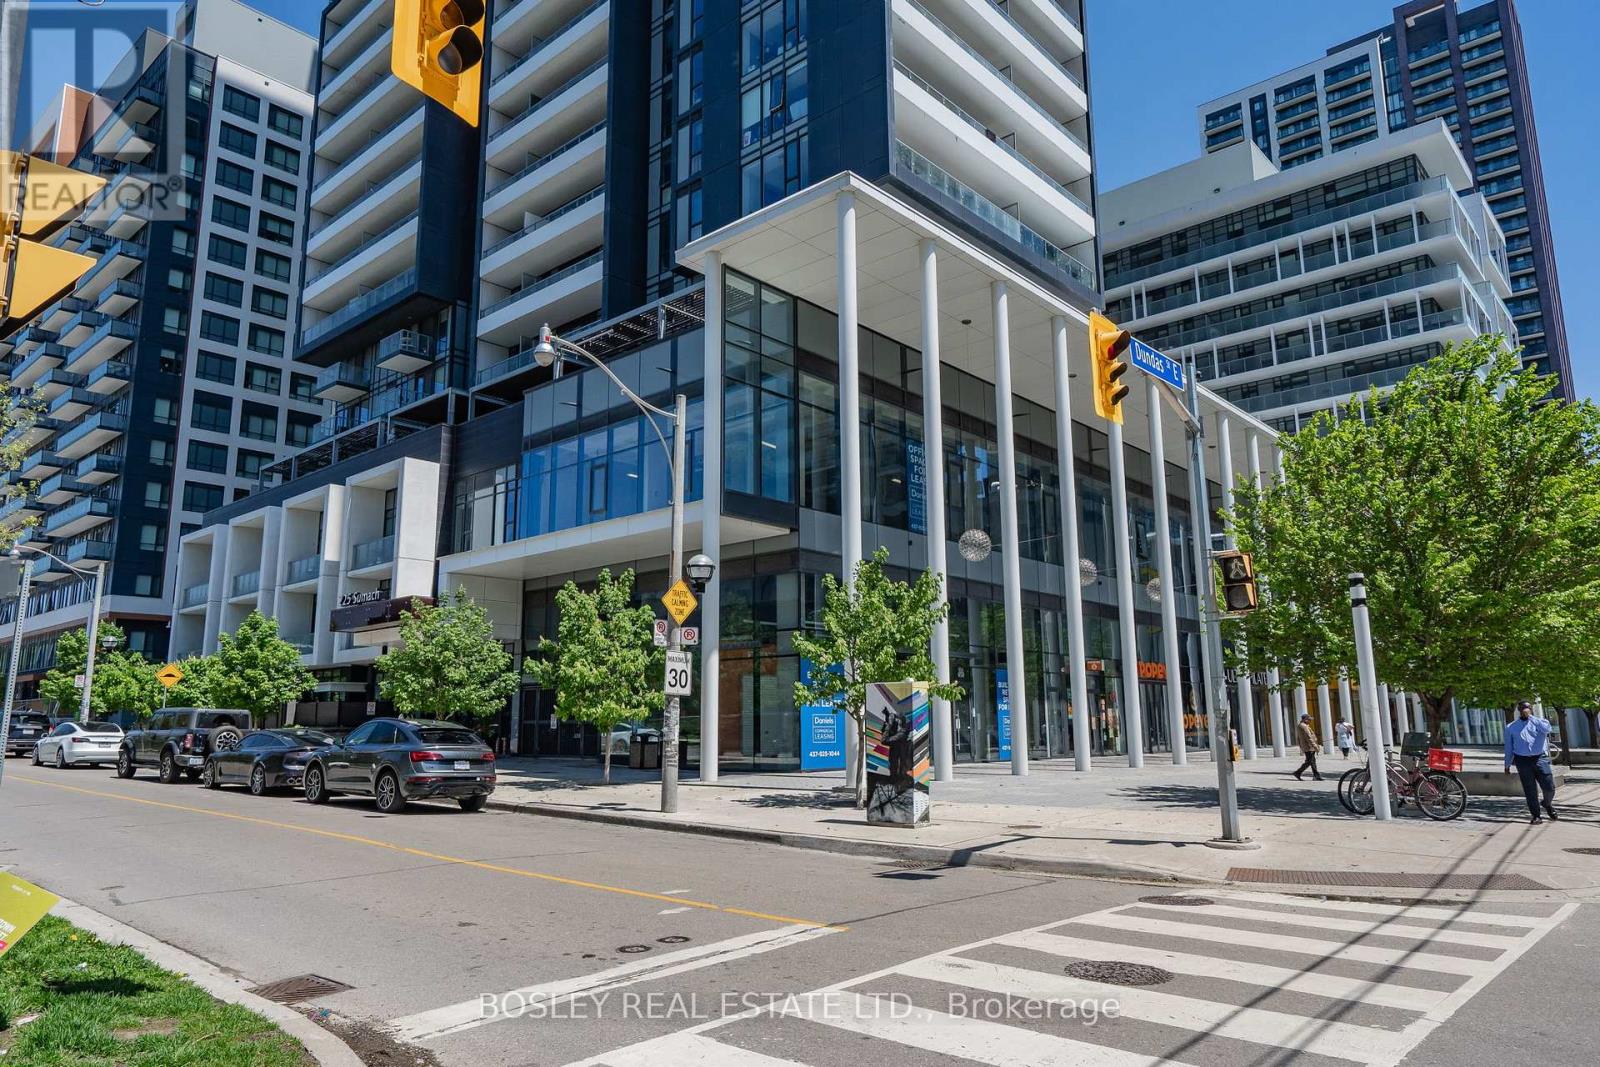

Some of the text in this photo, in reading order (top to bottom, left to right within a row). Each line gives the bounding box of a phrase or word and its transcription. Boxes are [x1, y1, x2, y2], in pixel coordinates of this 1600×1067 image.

[1134, 341, 1165, 374] Dundas
[1172, 362, 1179, 381] E
[908, 444, 924, 456] OFFI
[668, 668, 688, 689] 30
